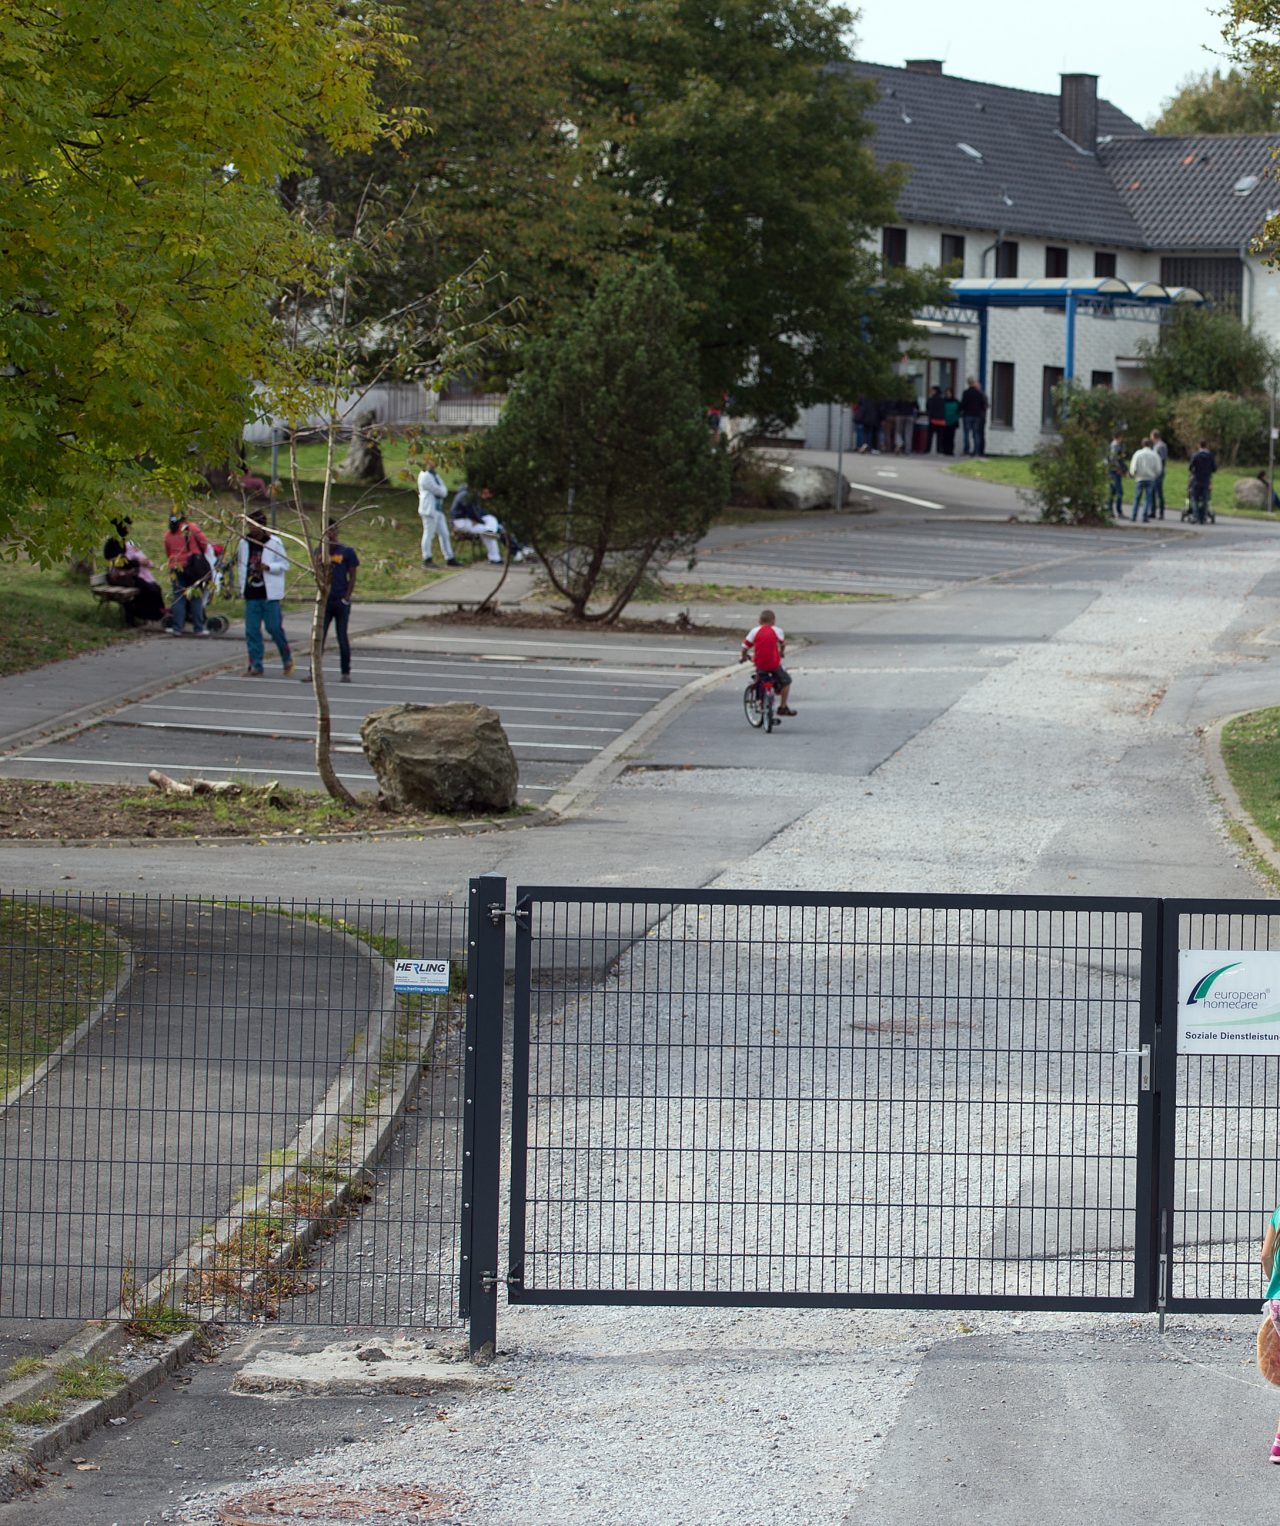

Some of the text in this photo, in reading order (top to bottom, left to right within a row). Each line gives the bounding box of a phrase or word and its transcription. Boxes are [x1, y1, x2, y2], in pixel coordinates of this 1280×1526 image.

[396, 963, 446, 974] HERLING
[1214, 991, 1267, 1002] european
[1203, 999, 1258, 1010] homecare
[1185, 1032, 1218, 1040] Soziale
